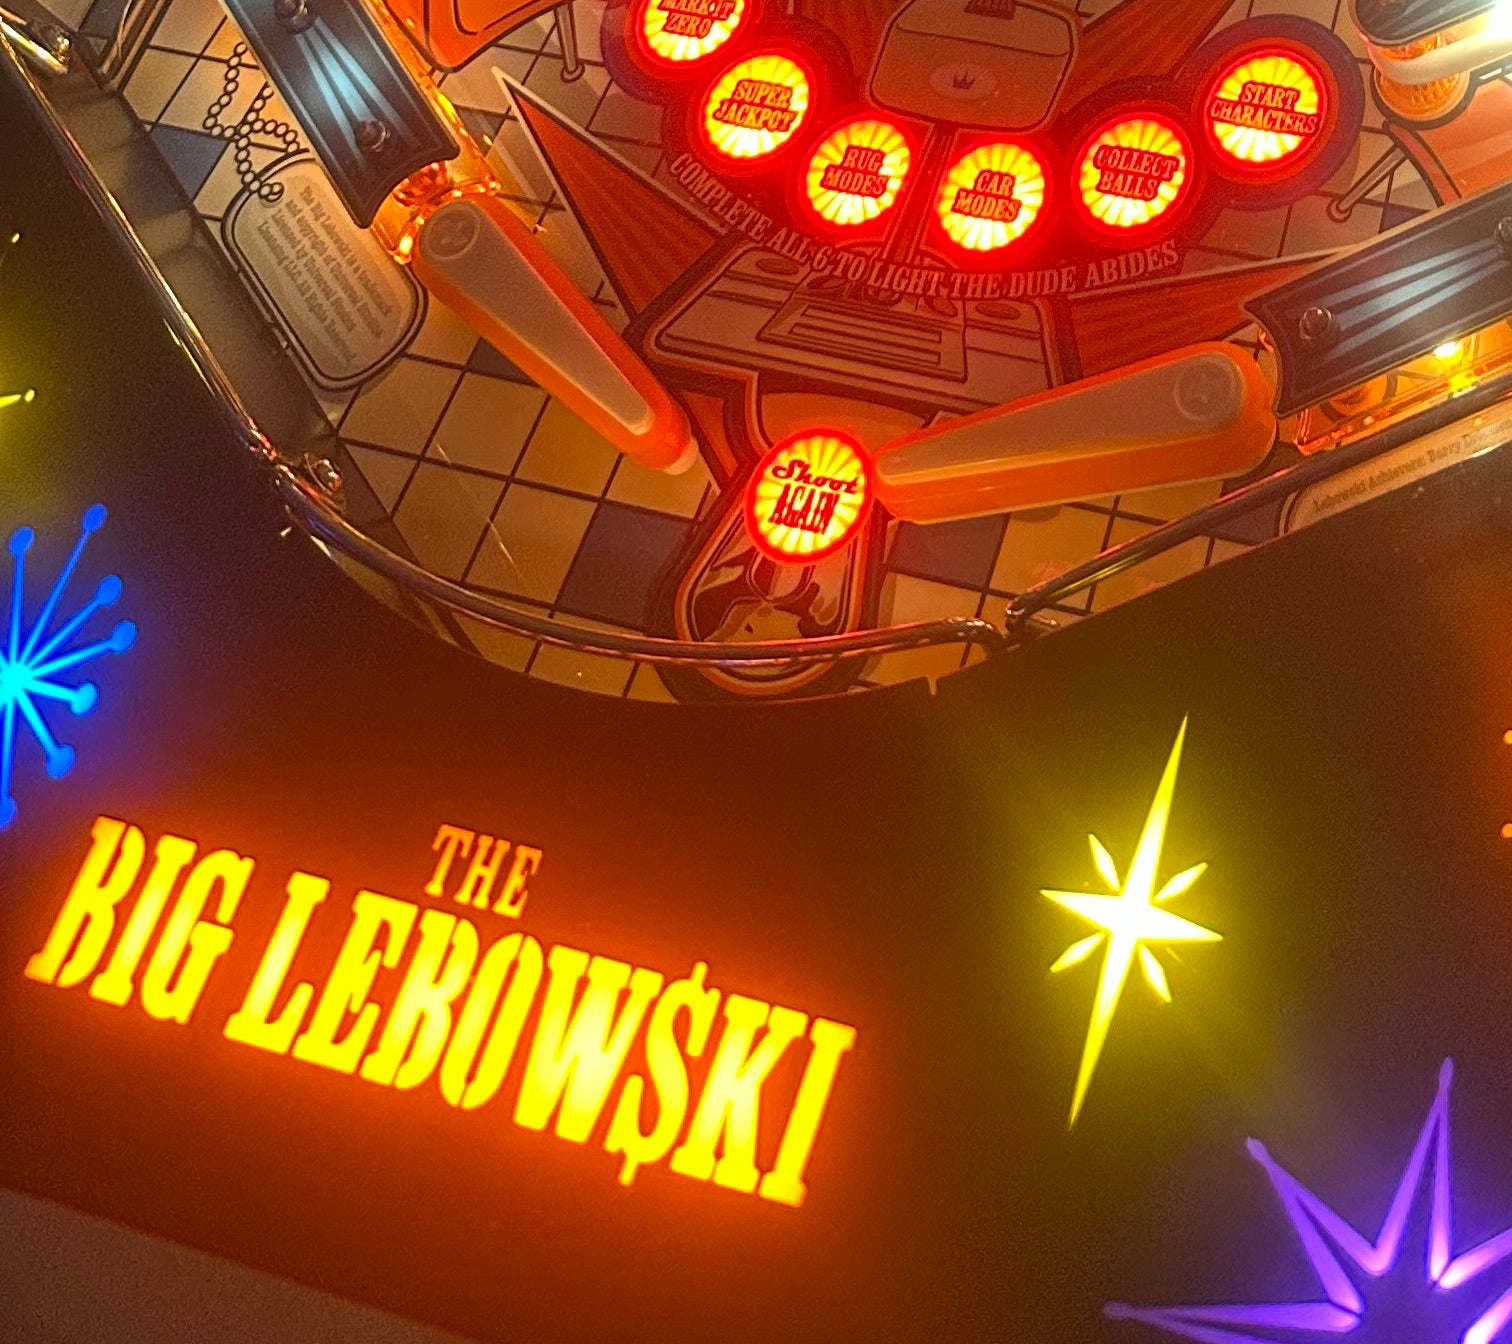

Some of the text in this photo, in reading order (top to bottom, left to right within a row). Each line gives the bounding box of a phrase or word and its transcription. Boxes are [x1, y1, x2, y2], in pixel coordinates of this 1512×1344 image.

[664, 12, 712, 36] ZERO
[711, 0, 736, 20] IT
[733, 80, 793, 109] SUPER
[1242, 82, 1298, 110] START
[715, 100, 796, 132] JACKPOT
[1210, 99, 1318, 135] CHARACTERS
[843, 148, 885, 173] RUG
[1096, 147, 1177, 179] COLLECT
[823, 166, 889, 196] MODES
[975, 171, 1015, 198] CAR
[1099, 170, 1158, 199] BALLS
[954, 191, 1021, 221] MODES
[669, 152, 1180, 299] COMPLETE ALL 6 TO LIGHT THE DUDE ABIDES
[770, 458, 860, 495] Shoot
[768, 483, 841, 536] AGAIN
[423, 822, 544, 920] THE
[23, 813, 256, 1025] BIG
